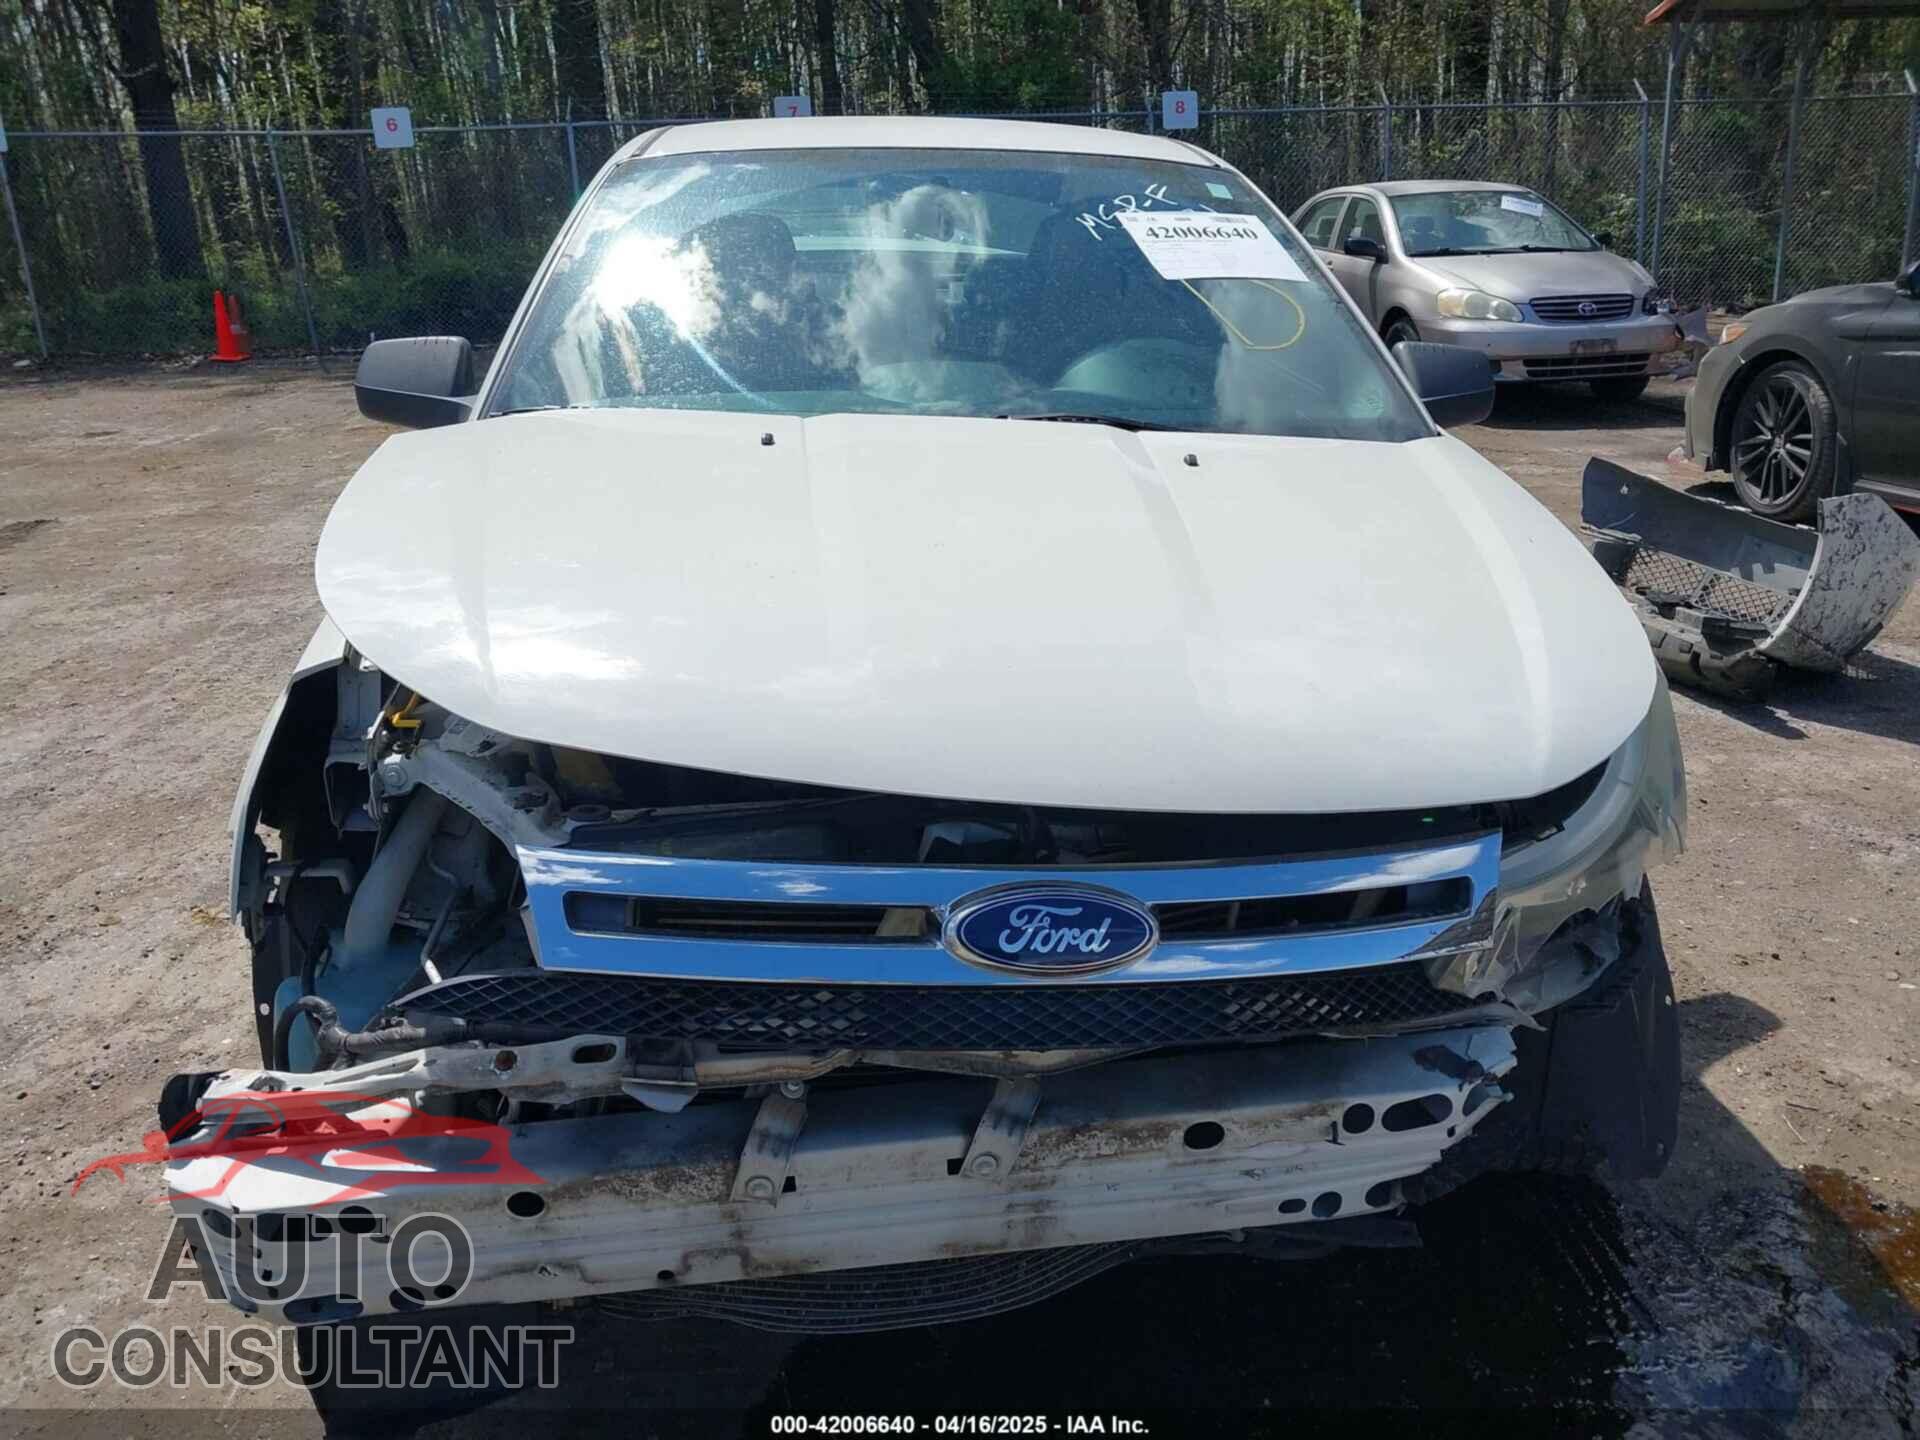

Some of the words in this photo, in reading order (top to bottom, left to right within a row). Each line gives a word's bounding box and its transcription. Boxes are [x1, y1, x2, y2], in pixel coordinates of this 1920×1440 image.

[1175, 100, 1185, 114] 8
[386, 117, 398, 132] 6
[1145, 224, 1259, 241] 42006640
[998, 904, 1113, 954] Ford
